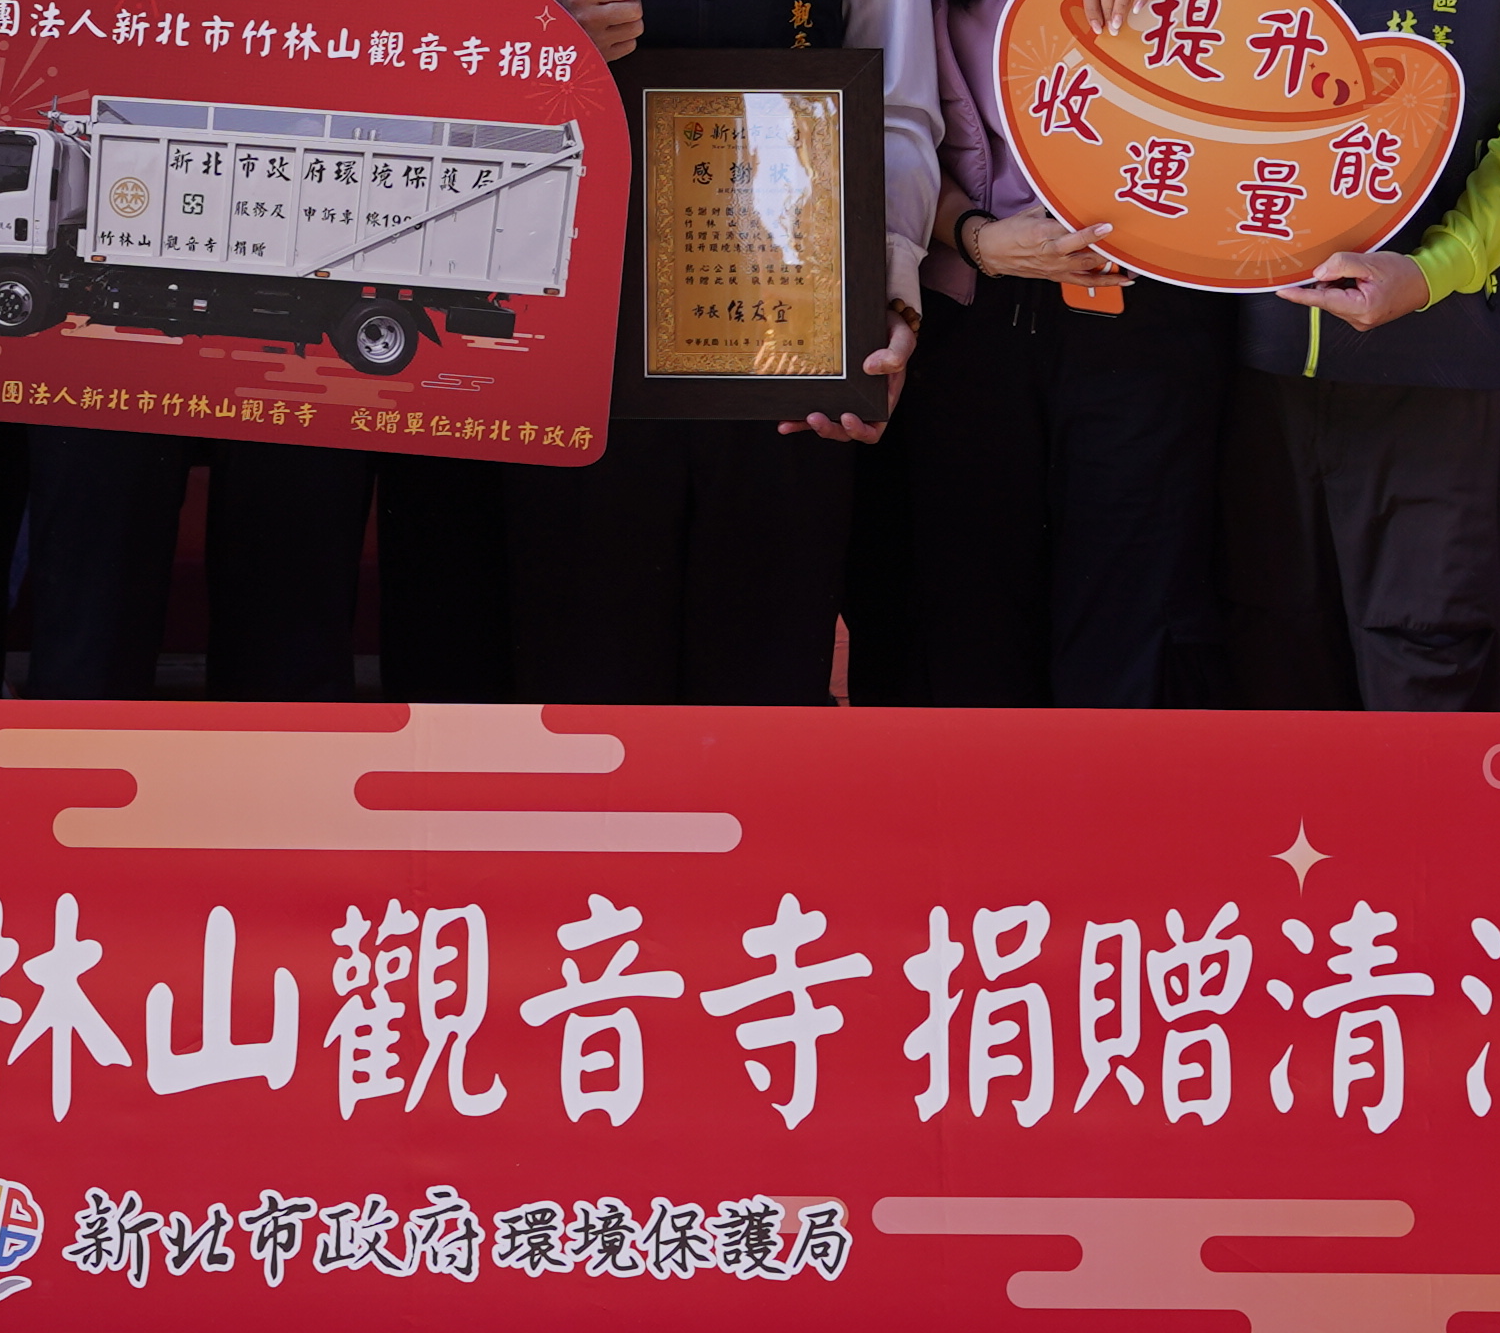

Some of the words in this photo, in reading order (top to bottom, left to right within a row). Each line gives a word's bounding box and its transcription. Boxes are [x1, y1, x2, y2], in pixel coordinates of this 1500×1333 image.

[1030, 61, 1403, 241] 收運量能
[692, 161, 790, 185] 感謝狀
[692, 304, 720, 319] 市長
[727, 299, 792, 323] 侯友宜
[349, 411, 594, 454] 受贈單位:新北市政府
[60, 1185, 850, 1282] 新北市政府環境保護局
